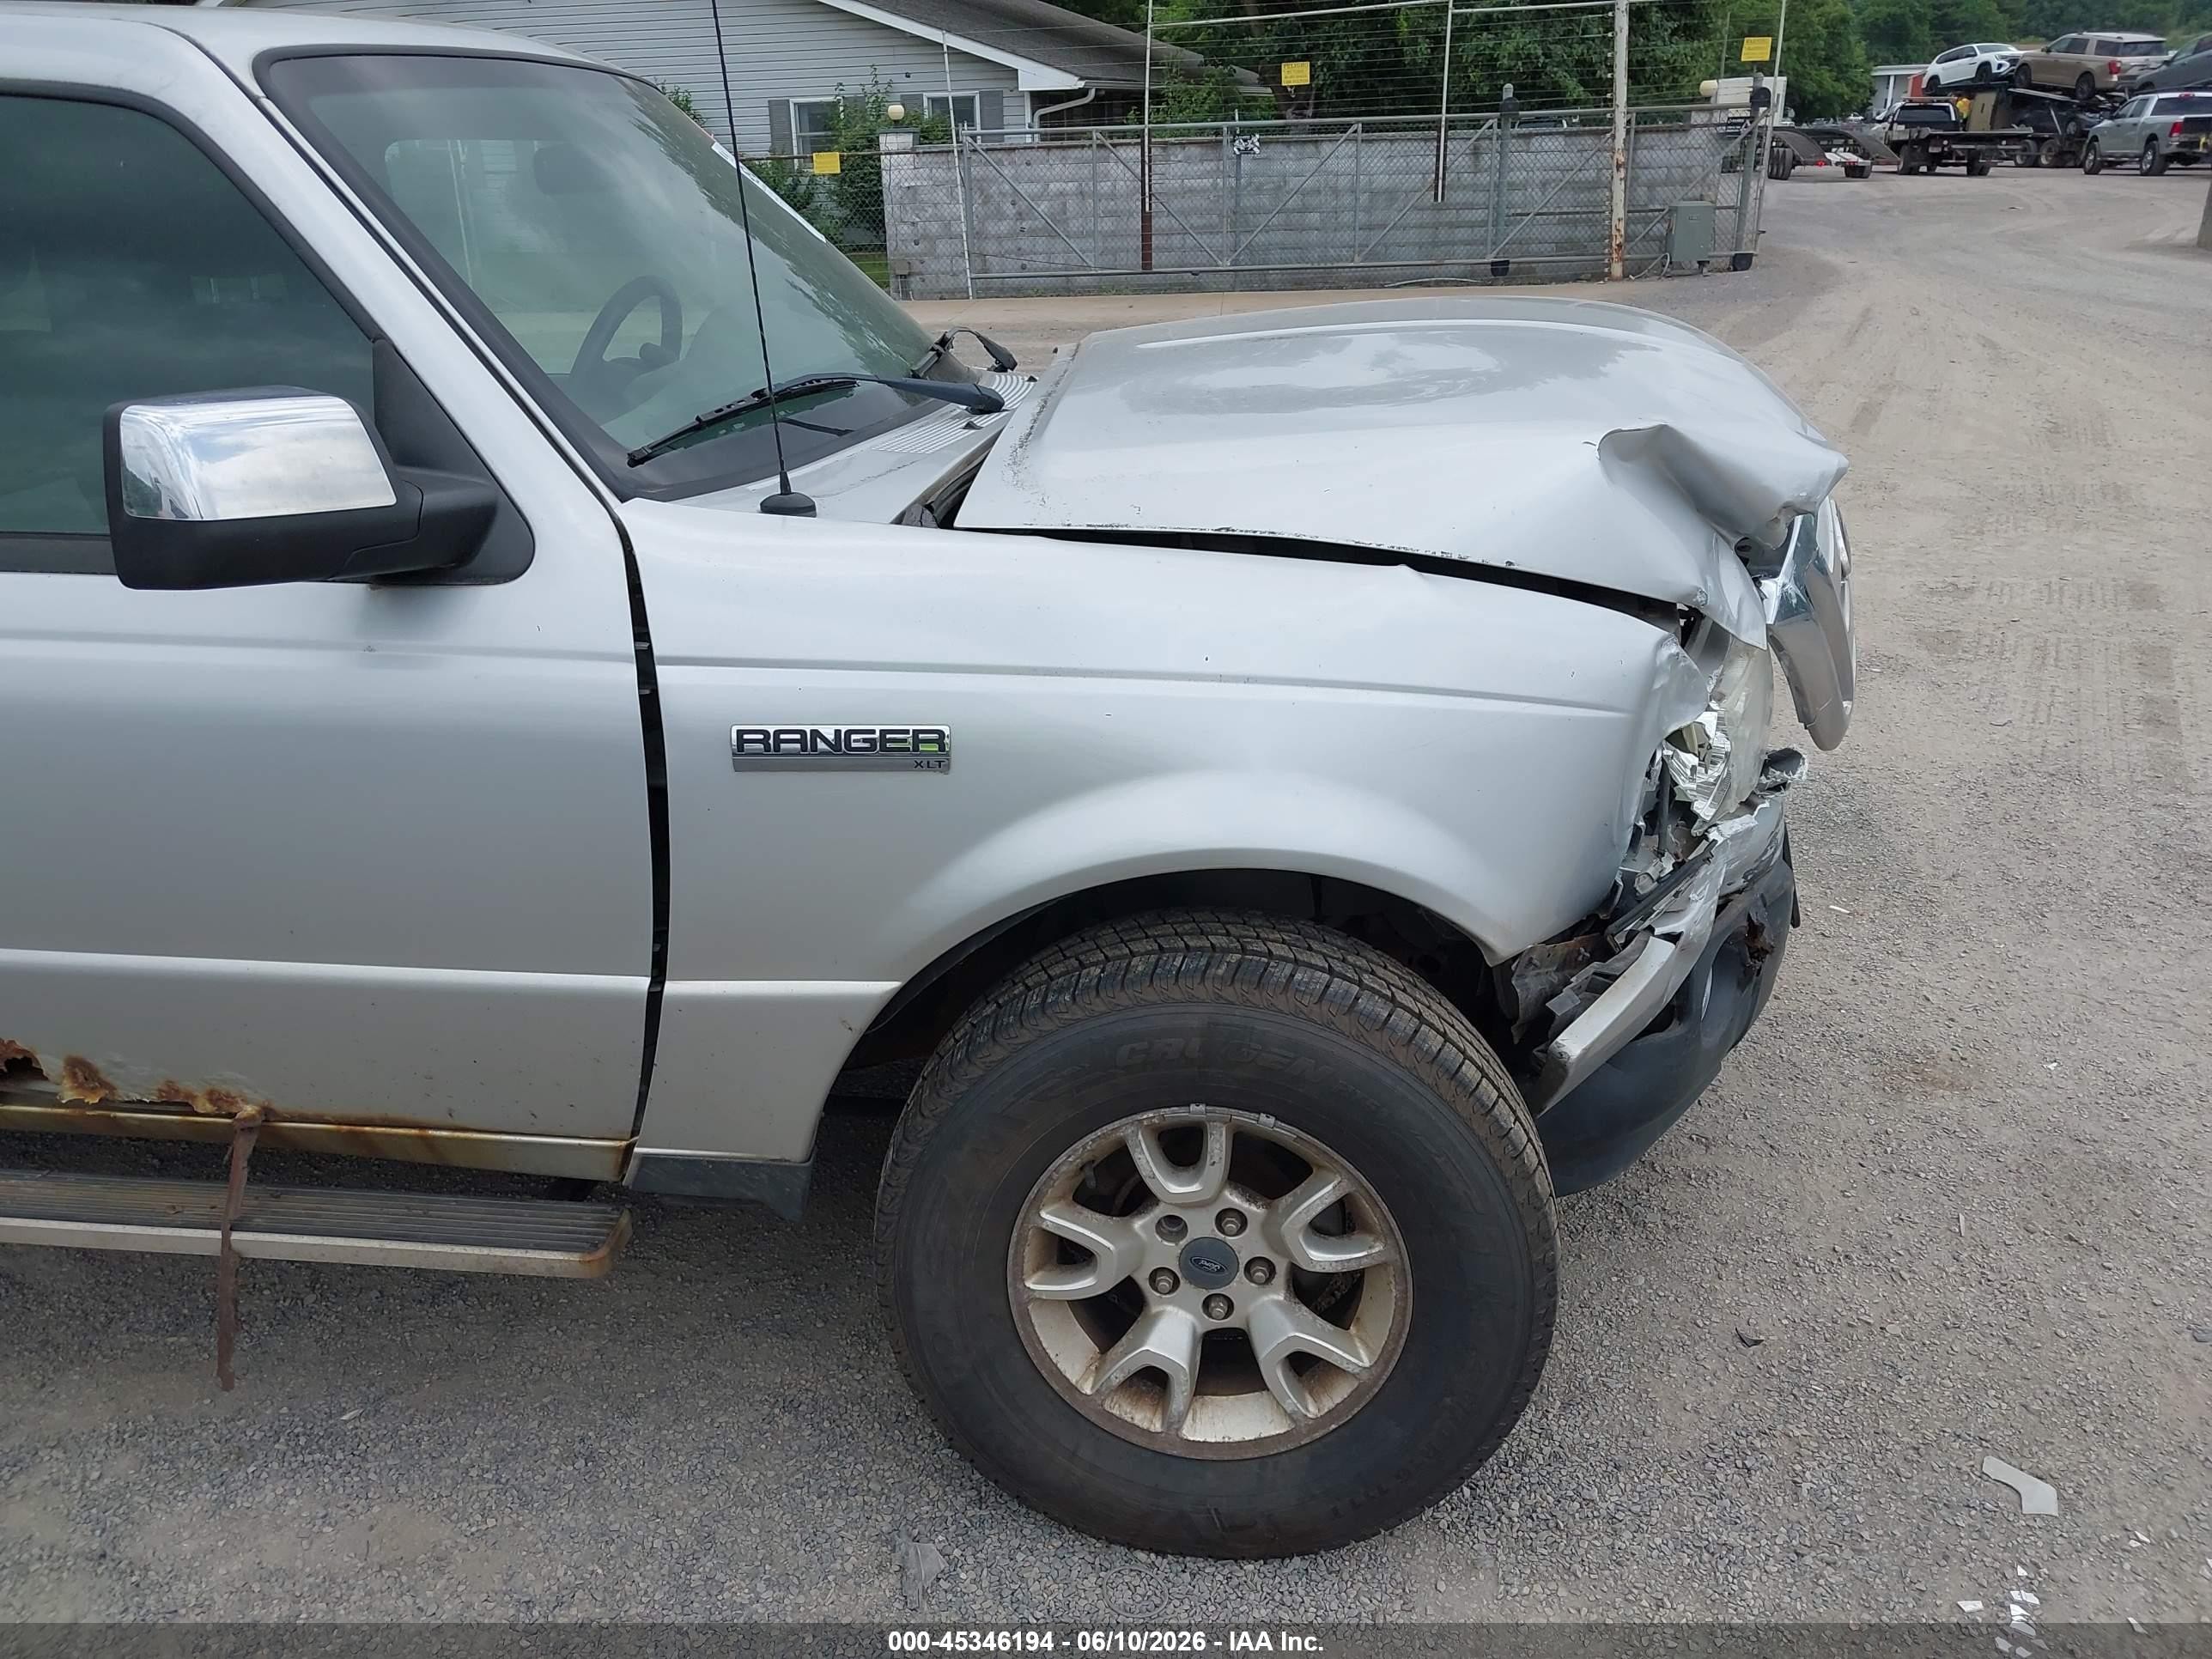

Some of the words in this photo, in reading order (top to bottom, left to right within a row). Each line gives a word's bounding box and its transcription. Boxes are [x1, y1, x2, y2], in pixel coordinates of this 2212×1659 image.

[736, 728, 947, 753] RANGER
[914, 760, 945, 769] XLT
[1198, 1259, 1220, 1273] Ford
